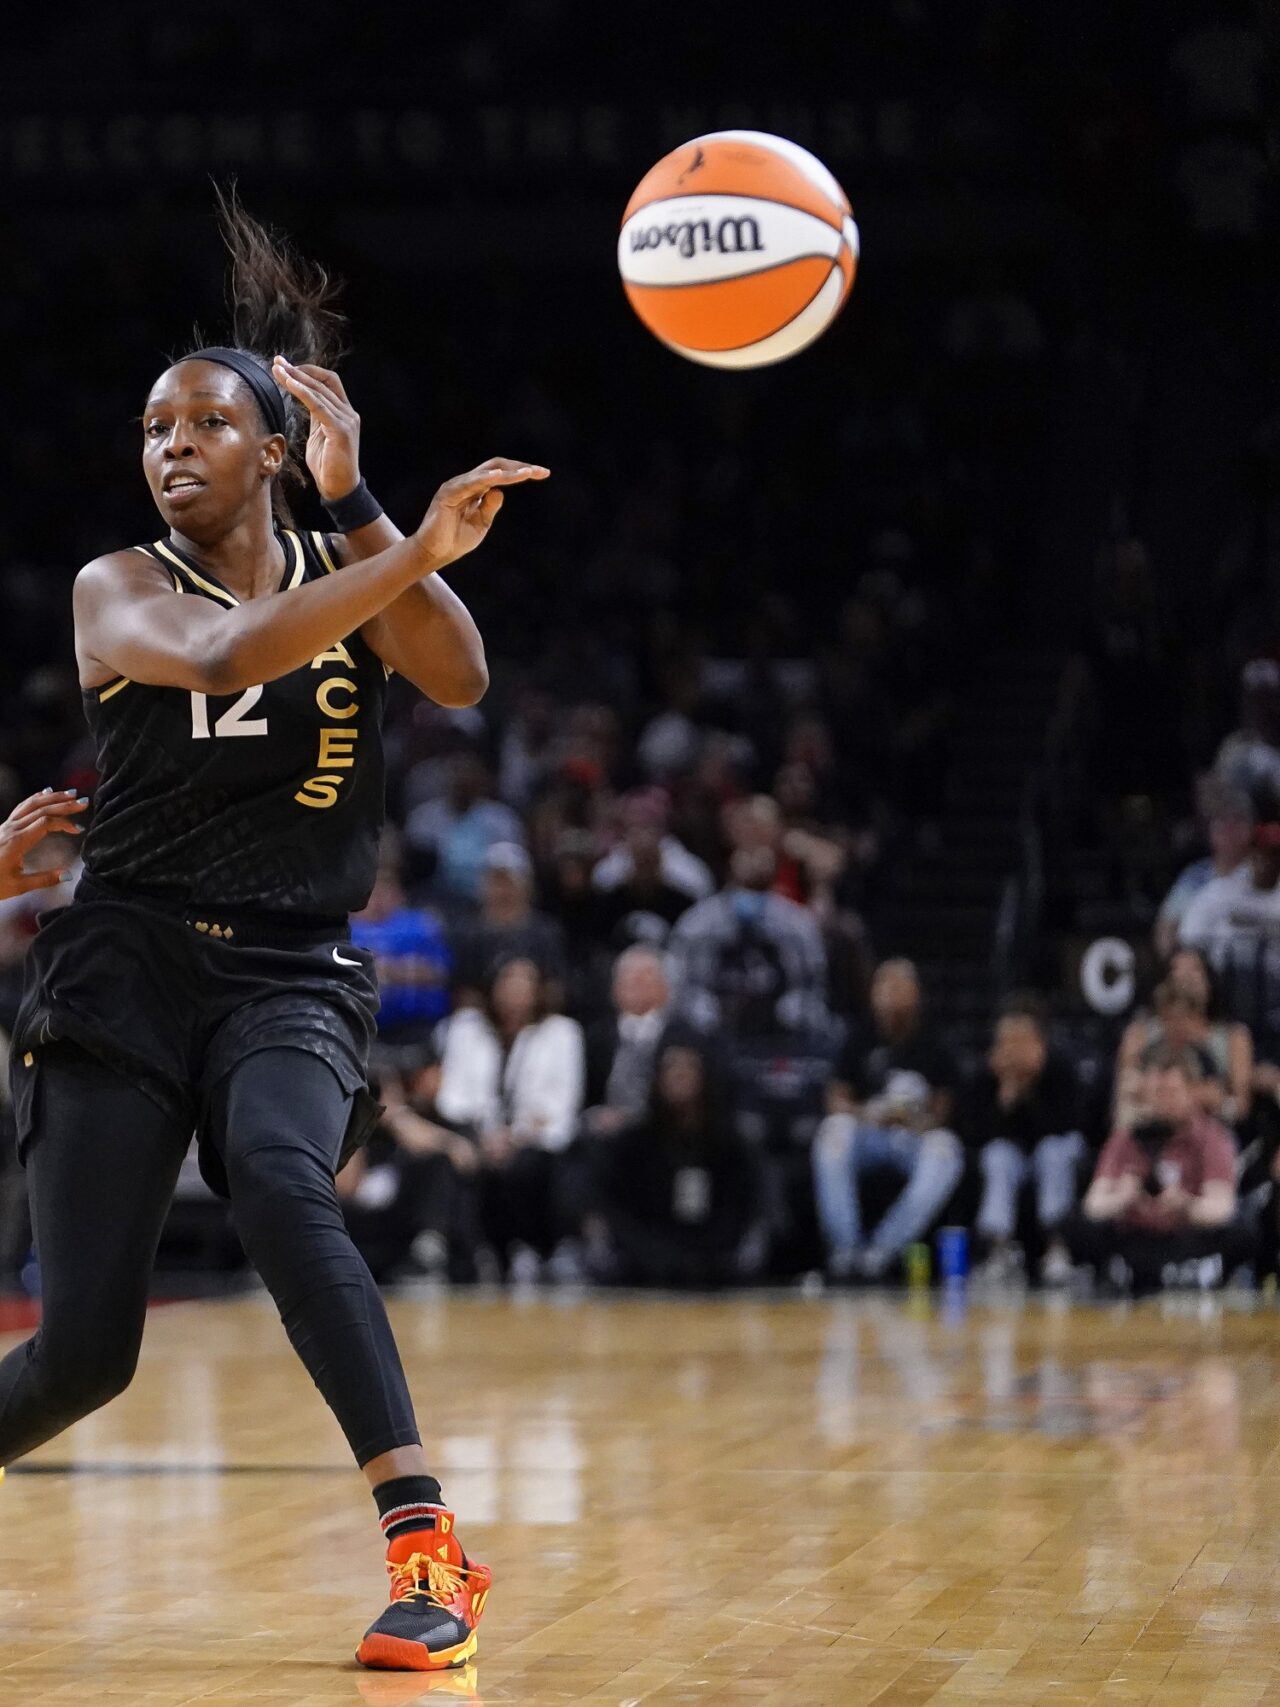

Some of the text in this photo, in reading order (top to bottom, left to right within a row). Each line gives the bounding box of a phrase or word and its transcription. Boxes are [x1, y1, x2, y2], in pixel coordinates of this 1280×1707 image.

[630, 215, 764, 257] Wilson
[191, 684, 268, 739] 12
[294, 641, 359, 808] ACES
[1081, 937, 1135, 1014] C
